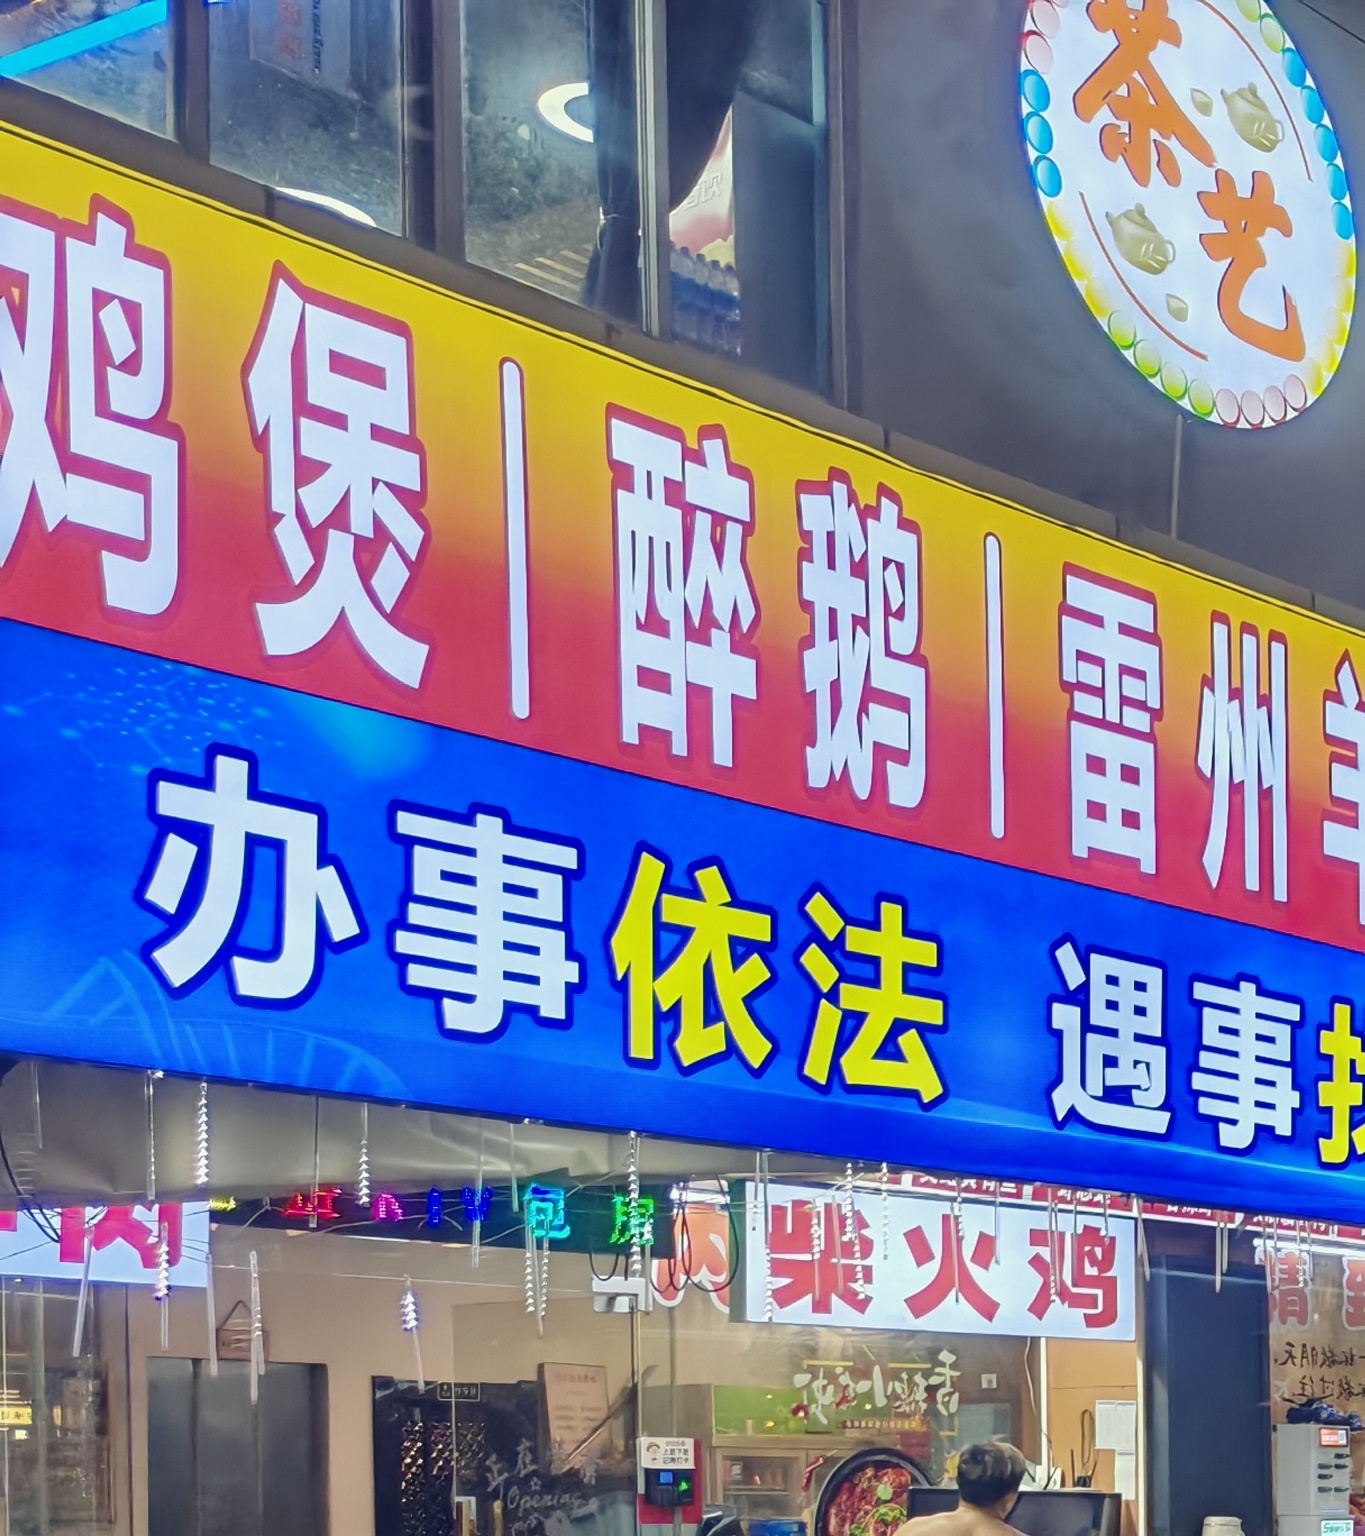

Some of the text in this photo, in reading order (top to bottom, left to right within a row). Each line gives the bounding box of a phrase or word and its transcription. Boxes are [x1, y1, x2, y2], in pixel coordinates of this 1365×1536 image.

[1073, 0, 1306, 362] 茶艺
[610, 416, 928, 808] 醉鹅
[145, 754, 945, 1103] 办事依法
[767, 1198, 1119, 1329] 柴火鸡
